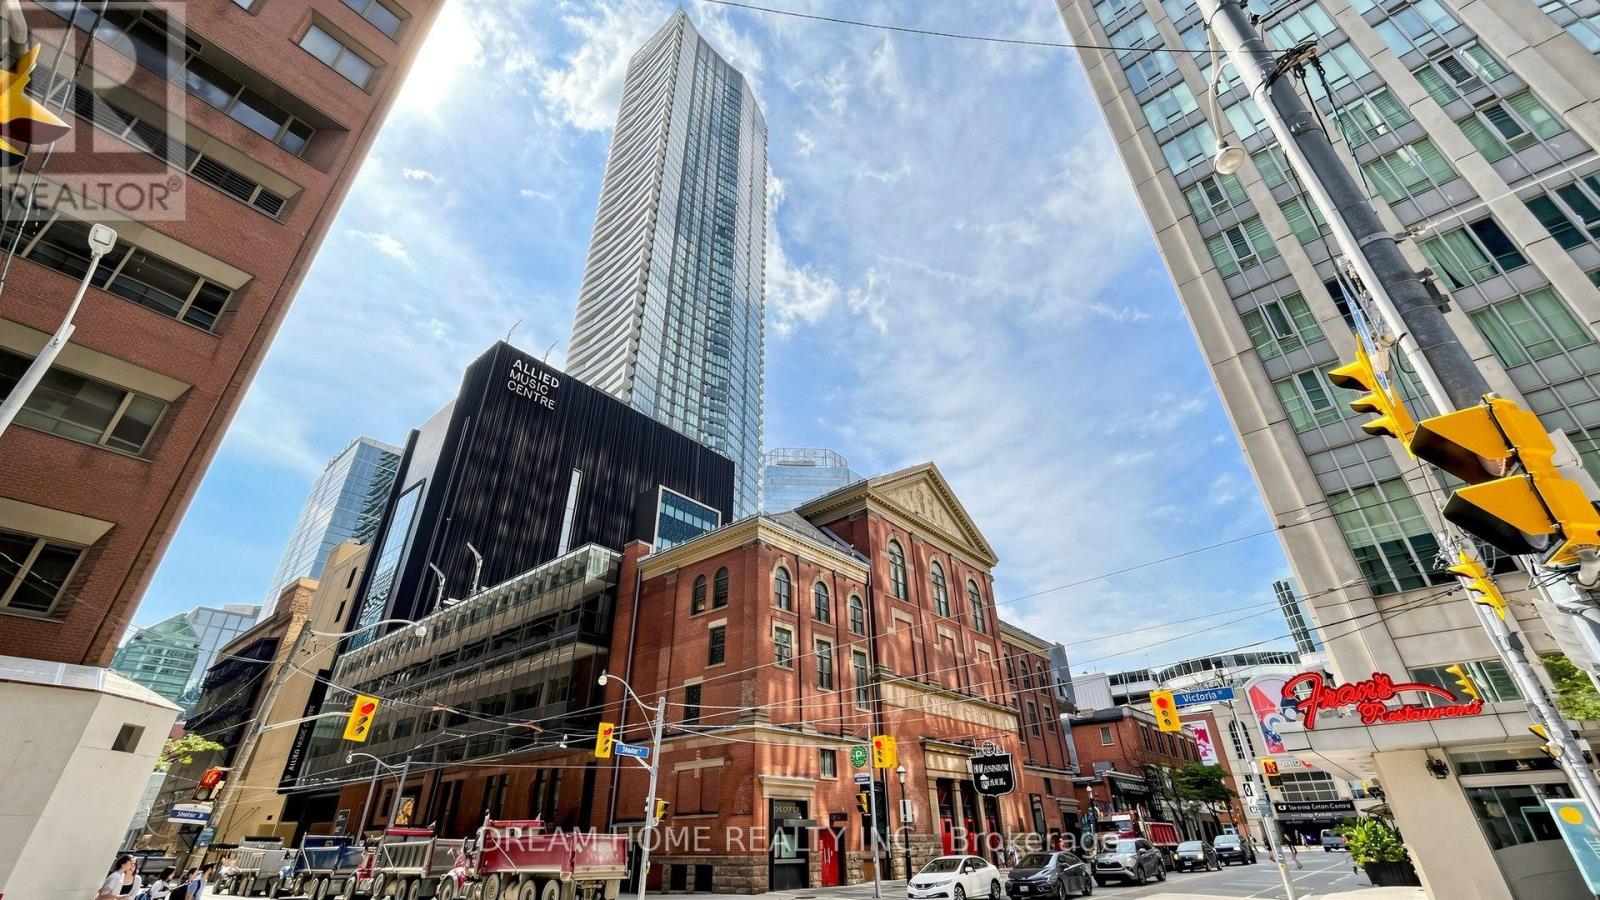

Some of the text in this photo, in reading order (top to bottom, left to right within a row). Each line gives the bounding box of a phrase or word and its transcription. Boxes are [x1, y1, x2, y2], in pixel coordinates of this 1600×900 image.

[509, 369, 549, 395] MUSIC
[512, 359, 560, 389] ALLIED
[507, 380, 556, 410] CENTRE
[1182, 691, 1217, 702] Victoria
[1281, 671, 1442, 731] Fran's
[1357, 699, 1484, 725] Restaurant
[855, 750, 862, 761] P
